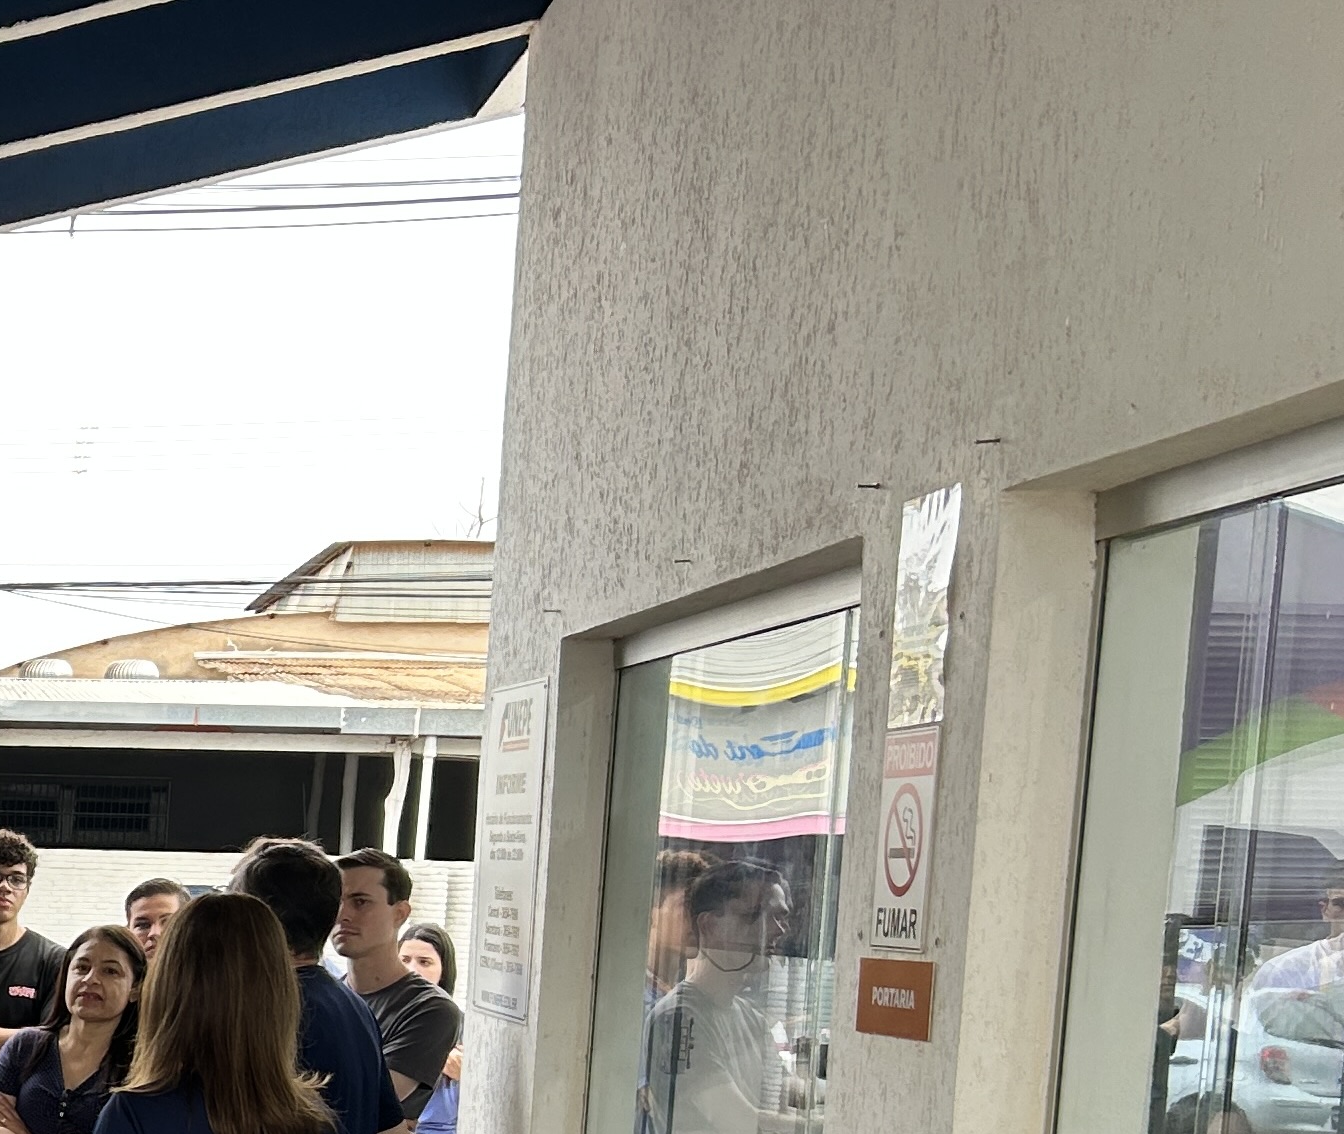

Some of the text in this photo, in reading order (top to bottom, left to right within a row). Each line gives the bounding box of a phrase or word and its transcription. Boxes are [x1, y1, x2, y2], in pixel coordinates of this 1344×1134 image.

[887, 741, 933, 771] PROIBIDO
[875, 907, 918, 939] FUMAR
[872, 986, 916, 1010] PORTARIA
